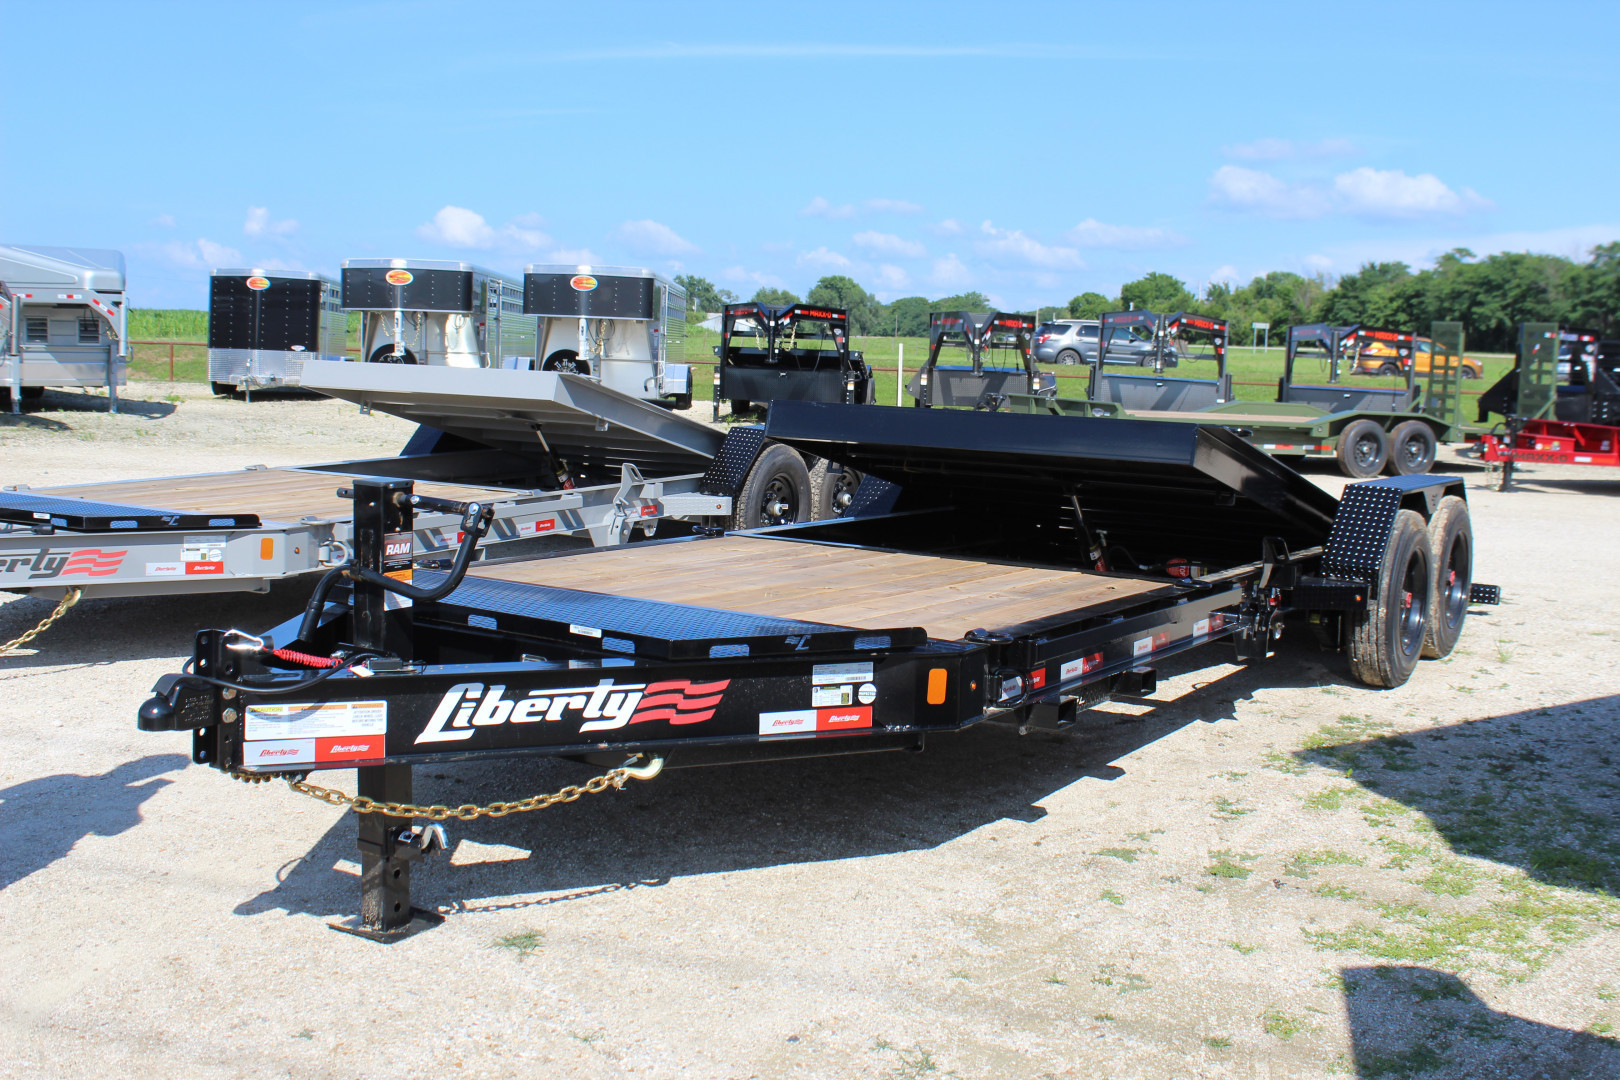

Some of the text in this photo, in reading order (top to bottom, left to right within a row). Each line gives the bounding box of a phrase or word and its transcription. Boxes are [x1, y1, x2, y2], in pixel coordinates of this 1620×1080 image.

[809, 309, 832, 318] MAXX-D
[385, 542, 411, 556] RAM
[413, 678, 647, 745] Liberty
[259, 748, 288, 757] Liberty
[329, 744, 358, 753] Liberty
